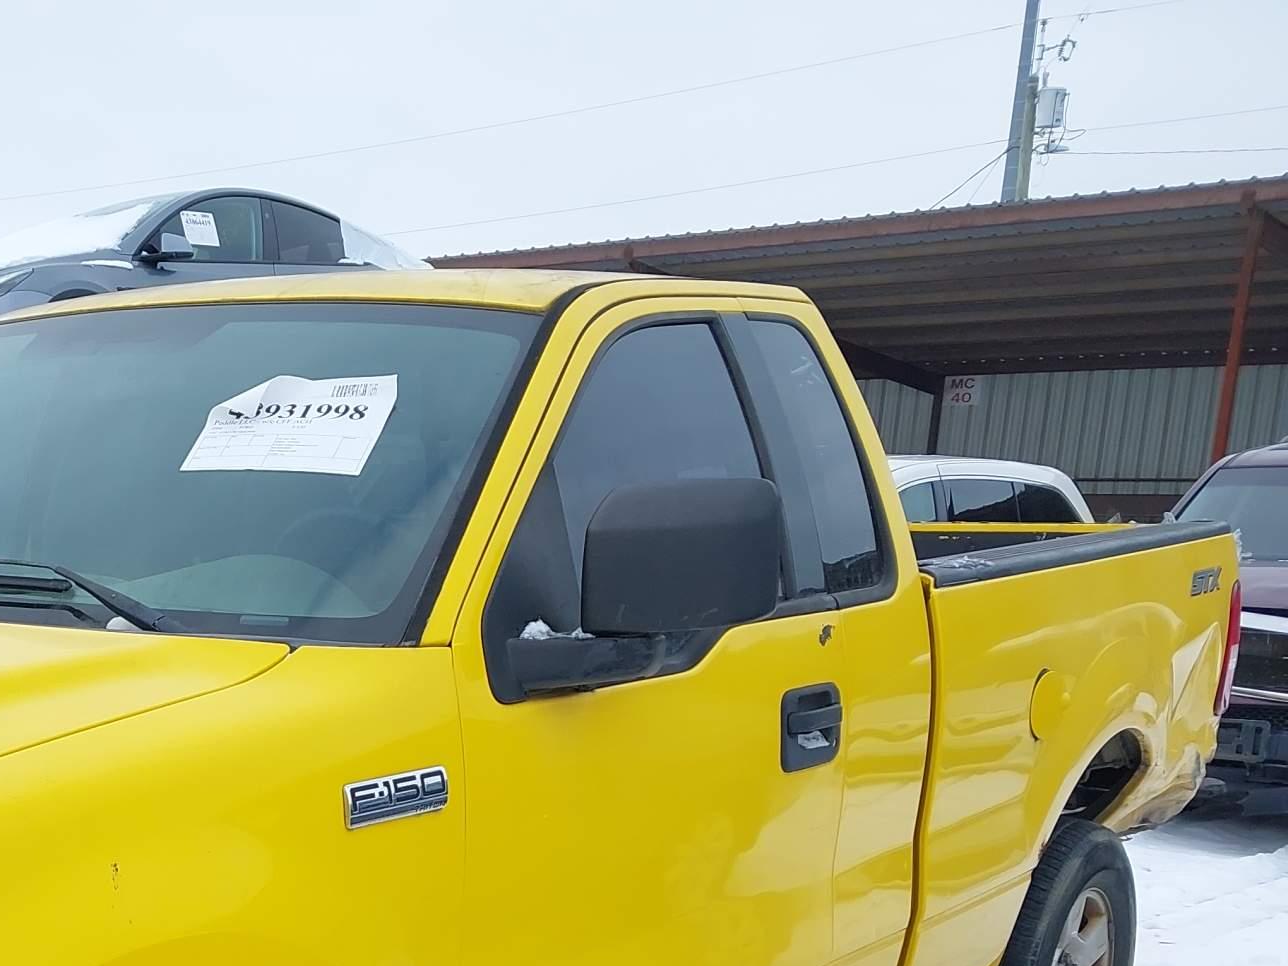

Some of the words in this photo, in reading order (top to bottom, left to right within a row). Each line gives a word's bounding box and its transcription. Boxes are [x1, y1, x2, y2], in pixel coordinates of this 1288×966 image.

[951, 378, 975, 389] MC
[951, 392, 972, 403] 40
[1191, 567, 1222, 597] STX
